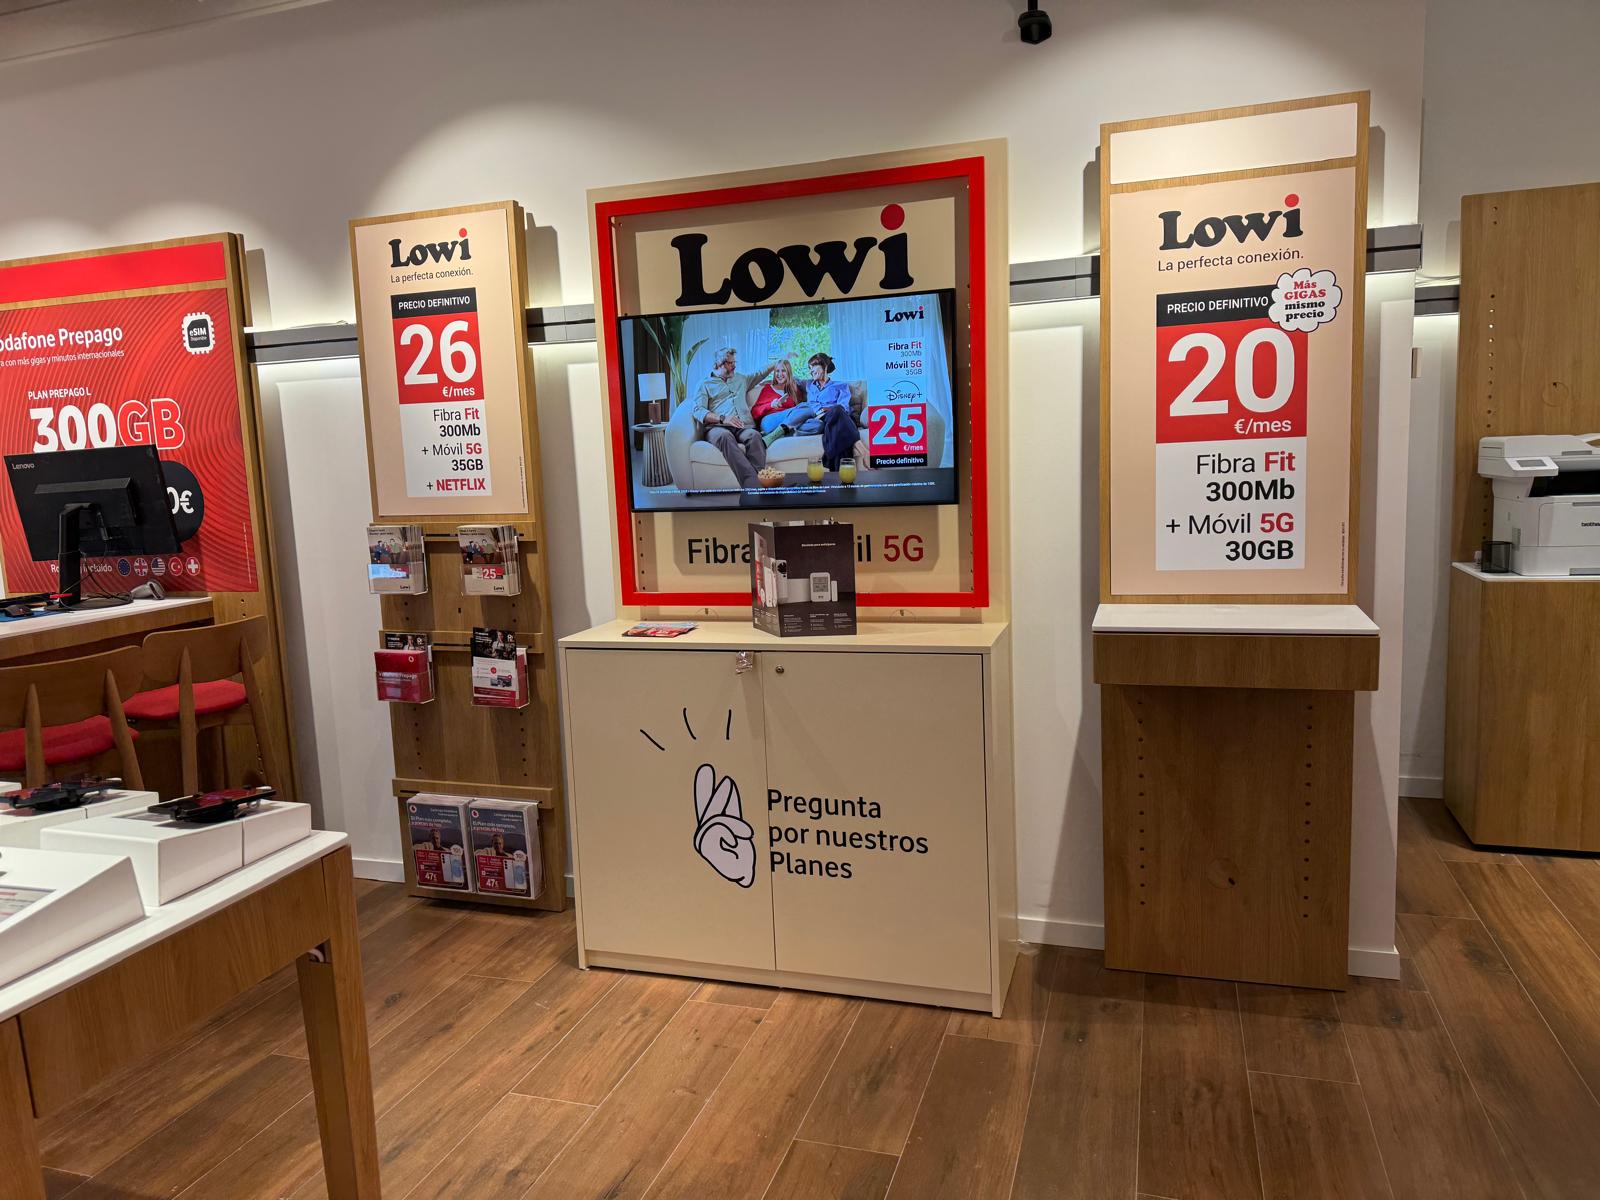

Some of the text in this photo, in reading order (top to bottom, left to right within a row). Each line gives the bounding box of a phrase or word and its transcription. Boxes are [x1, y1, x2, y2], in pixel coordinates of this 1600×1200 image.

[1158, 193, 1303, 251] Lowi
[388, 227, 472, 268] Lowi
[670, 203, 914, 307] Lowi
[1158, 248, 1304, 273] La perfecta conexión.
[390, 267, 474, 284] La perfecta conexión.
[1293, 280, 1317, 290] Más
[398, 295, 471, 310] PRECIO DEFINITIVO
[1284, 289, 1326, 300] GIGAS
[1167, 296, 1269, 314] PRECIO DEFINITIVO
[1284, 300, 1325, 310] mismo
[884, 305, 925, 323] Lowi
[1285, 310, 1325, 323] precio
[58, 326, 123, 347] Prepago
[189, 326, 207, 336] eSIM
[400, 320, 477, 386] 26
[888, 341, 922, 351] Fibra Fit
[5, 359, 17, 367] con
[17, 357, 30, 366] más
[30, 356, 46, 367] gigas
[47, 356, 51, 365] y
[52, 353, 77, 363] minutos
[77, 349, 125, 361] internacionales
[885, 360, 922, 370] Móvil 5G
[1168, 327, 1295, 417] 20
[28, 387, 92, 400] PLAN PREPAGO L
[442, 386, 476, 398] €/mes
[433, 407, 480, 422] Fibra Fit
[29, 397, 186, 453] 300GB
[439, 423, 481, 437] 300Mb
[871, 406, 924, 445] 25
[1233, 418, 1292, 435] €/mes
[421, 442, 483, 456] + Móvil 5G
[903, 444, 924, 452] €/mes
[11, 462, 35, 470] Lenovo
[451, 458, 484, 472] 35GB
[876, 456, 925, 465] Precio definitivo
[1196, 450, 1296, 475] Fibra Fit
[426, 478, 486, 492] + NETFLIX
[1205, 478, 1295, 502] 300Mb
[1166, 512, 1295, 535] + Móvil 5G
[687, 536, 751, 565] Fibra
[883, 534, 925, 563] 5G
[1225, 539, 1294, 562] 30GB
[482, 568, 497, 579] 25
[767, 788, 882, 820] Pregunta
[768, 824, 929, 854] por nuestros
[770, 851, 853, 879] Planes
